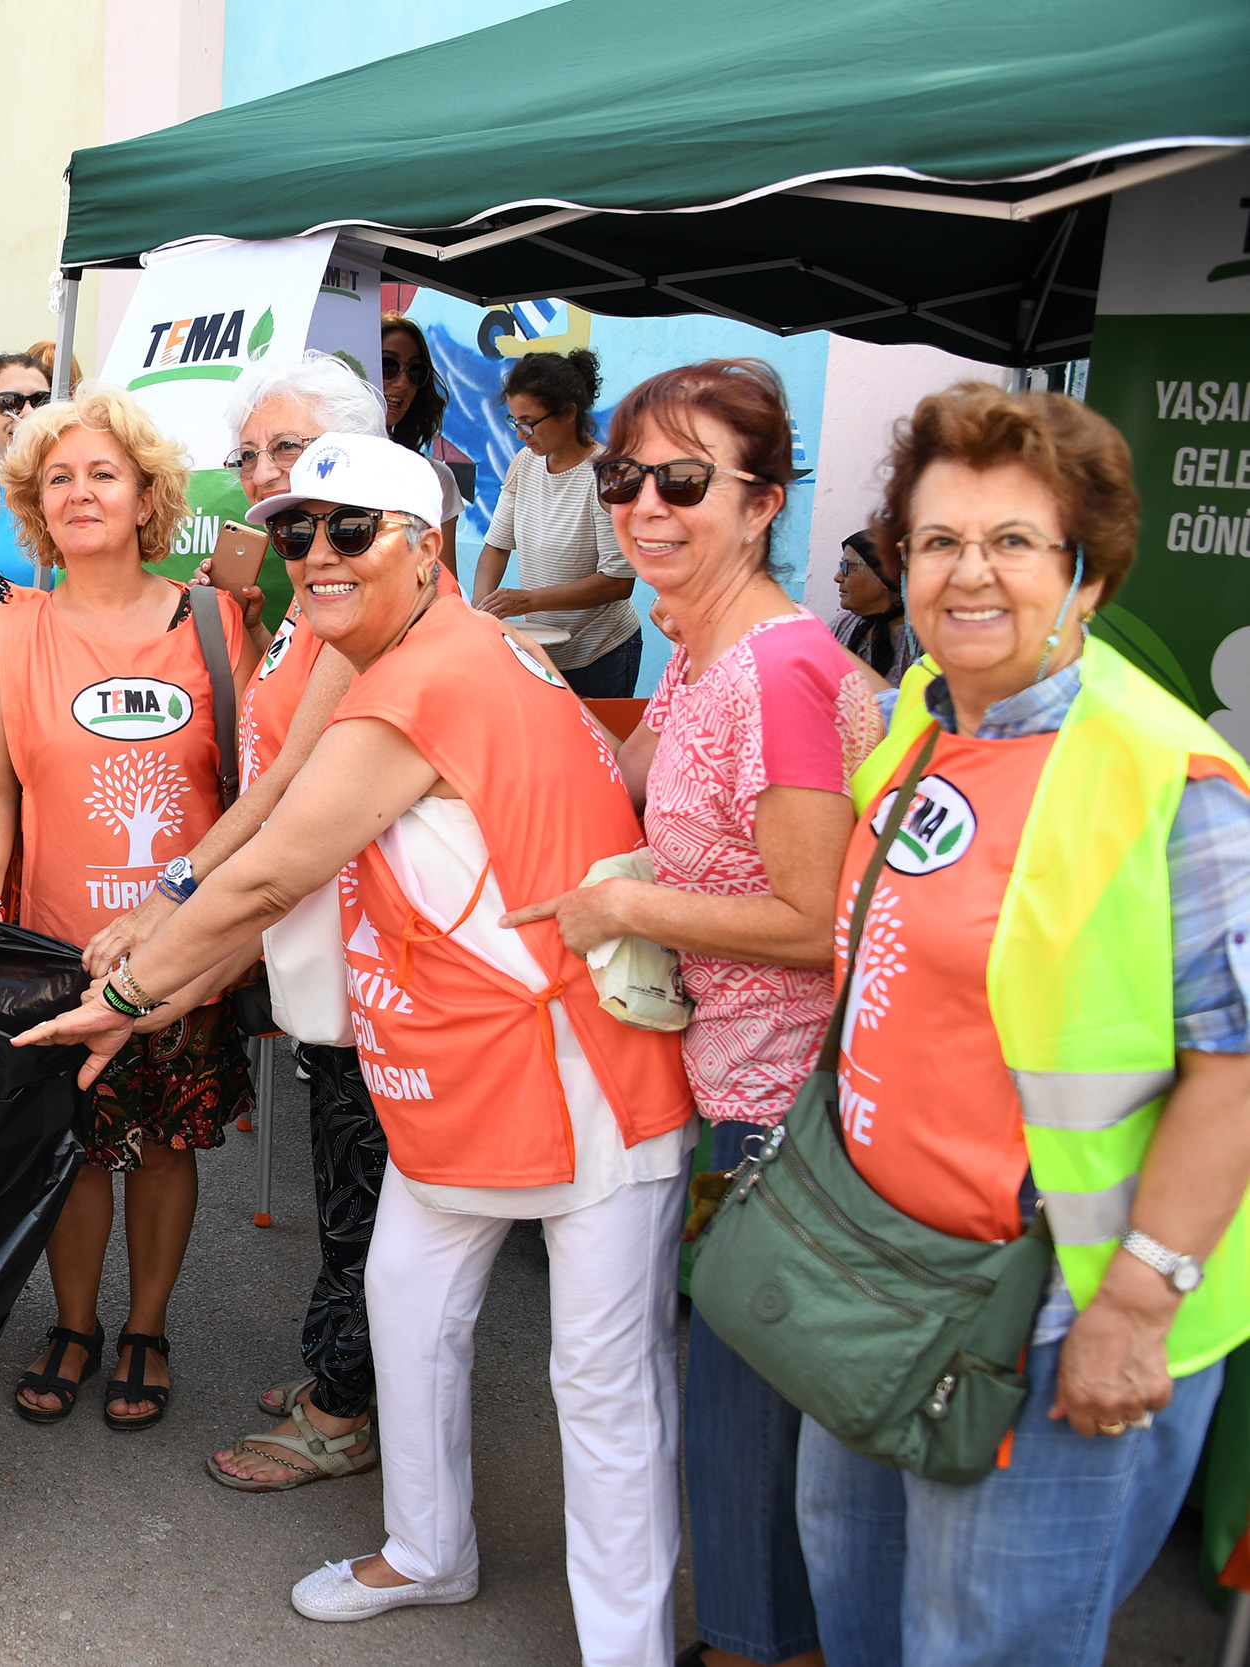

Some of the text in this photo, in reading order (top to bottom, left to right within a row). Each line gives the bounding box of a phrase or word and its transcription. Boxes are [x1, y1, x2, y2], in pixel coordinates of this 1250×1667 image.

[143, 309, 245, 368] TEMA
[1156, 380, 1250, 426] YAŞA
[170, 507, 219, 554] SİN
[97, 690, 160, 714] TEMA
[899, 792, 948, 843] EMA
